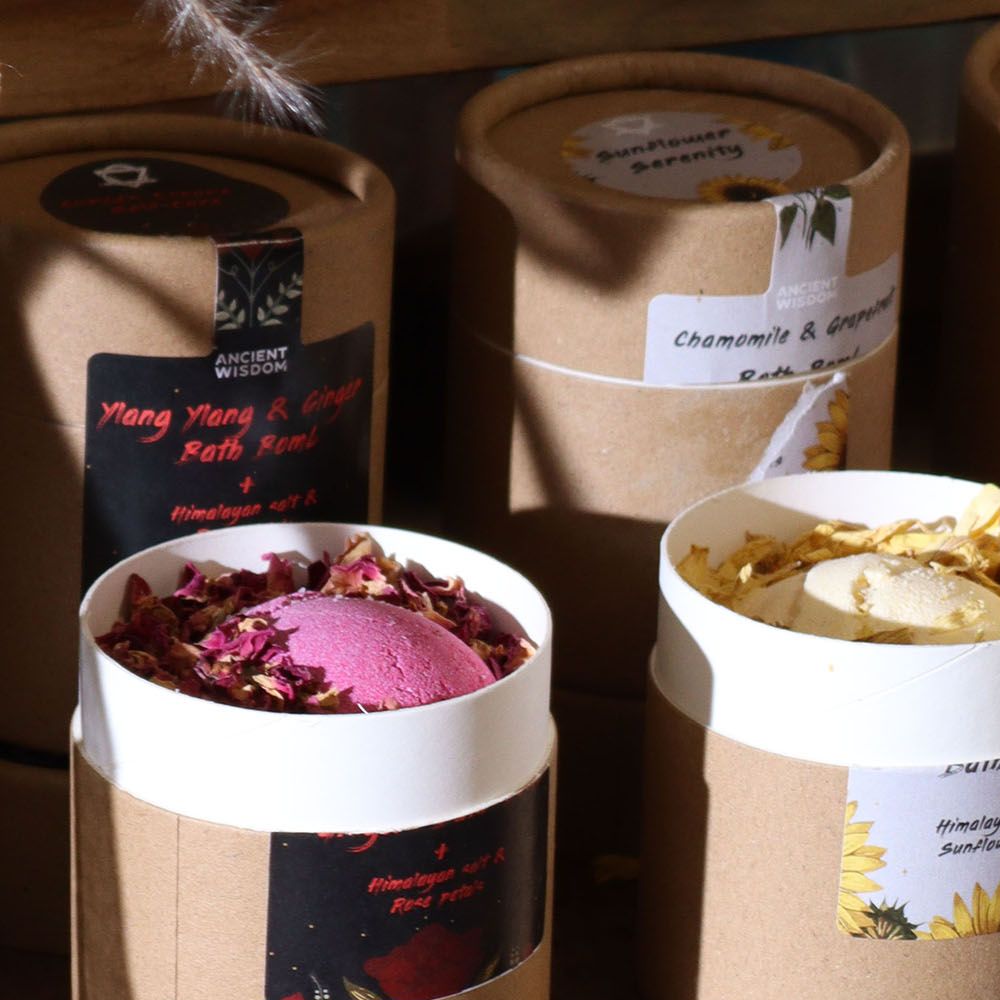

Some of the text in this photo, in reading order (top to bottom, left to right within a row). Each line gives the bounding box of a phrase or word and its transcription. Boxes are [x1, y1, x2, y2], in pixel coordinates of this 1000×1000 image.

[630, 144, 745, 174] Serenity
[674, 326, 791, 350] Chamomile
[799, 320, 816, 342] &
[215, 347, 289, 366] ANCIENT
[215, 360, 288, 379] WISDOM
[97, 402, 172, 444] Ylang
[180, 402, 255, 440] Ylang
[267, 396, 289, 421] &
[175, 426, 319, 466] Bath Bomb
[171, 503, 262, 527] Himalayan
[367, 867, 457, 895] Himalayan
